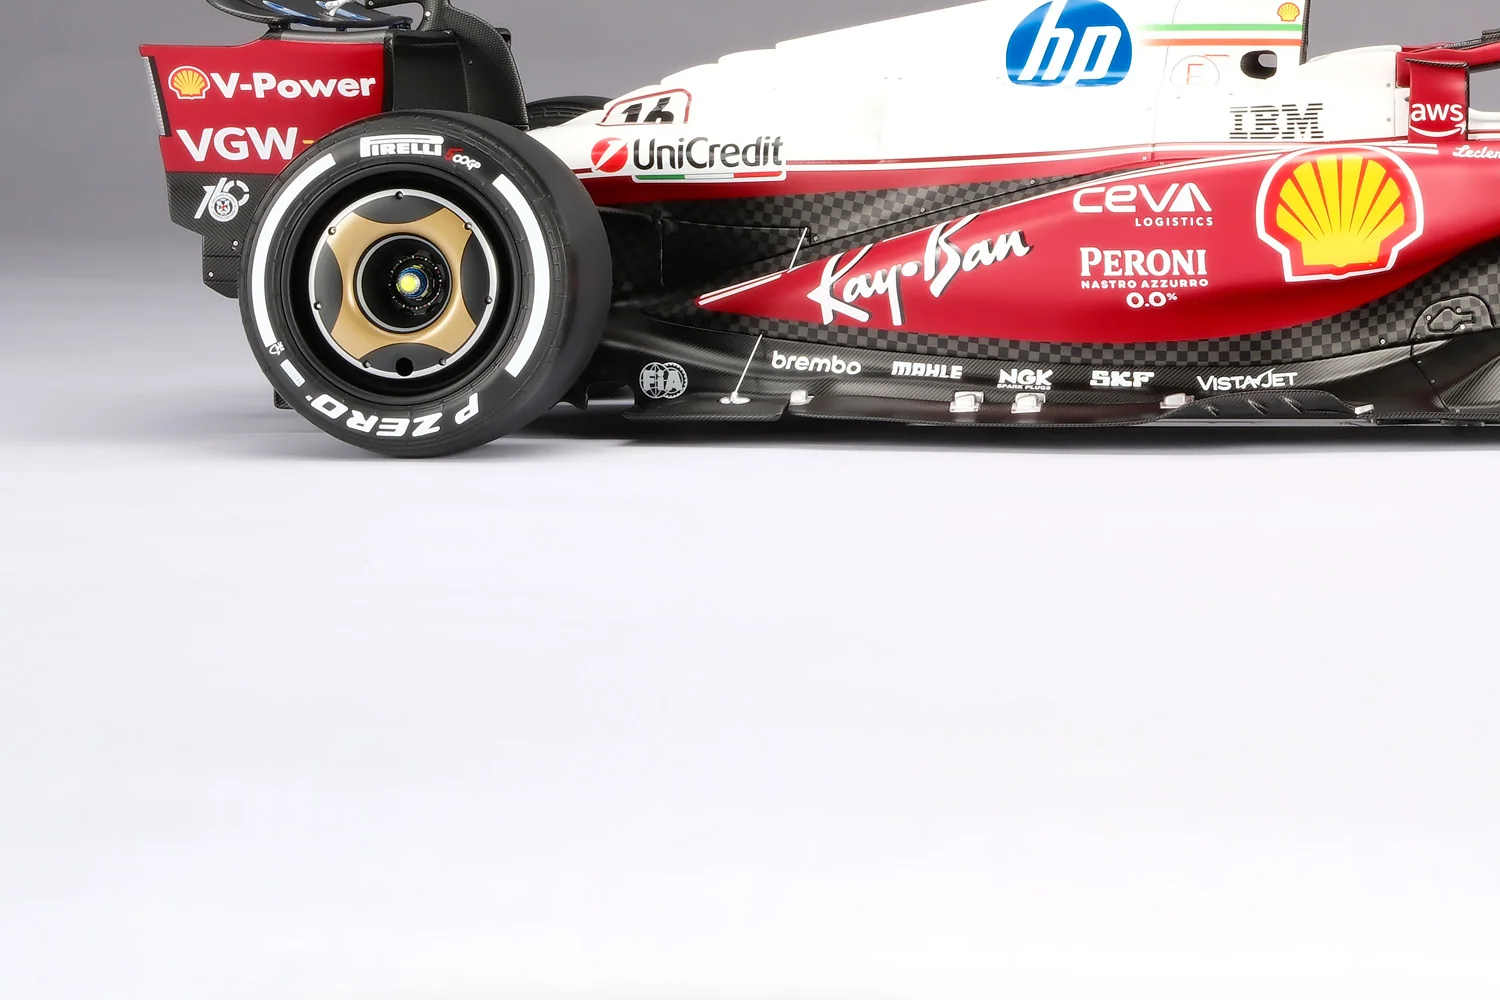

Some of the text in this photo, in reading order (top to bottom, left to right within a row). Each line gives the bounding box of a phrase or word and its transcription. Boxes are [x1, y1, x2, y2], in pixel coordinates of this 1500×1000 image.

[210, 72, 376, 98] V-Power
[1229, 103, 1324, 139] IBM
[1410, 103, 1464, 123] aws
[176, 127, 298, 162] VGW
[360, 134, 444, 158] PIRELLI
[633, 136, 784, 170] UniCredit
[1135, 217, 1213, 227] LOGISTICS
[1080, 247, 1207, 276] PERONI
[1081, 279, 1209, 289] NASTRO AZZURRO
[1126, 291, 1178, 308] 0.0%
[772, 350, 862, 375] brembo
[891, 361, 963, 379] MAHLE
[998, 368, 1054, 385] NGK
[1090, 370, 1155, 387] SKF
[1196, 367, 1298, 391] VISTAJET
[310, 392, 479, 437] P ZERO
